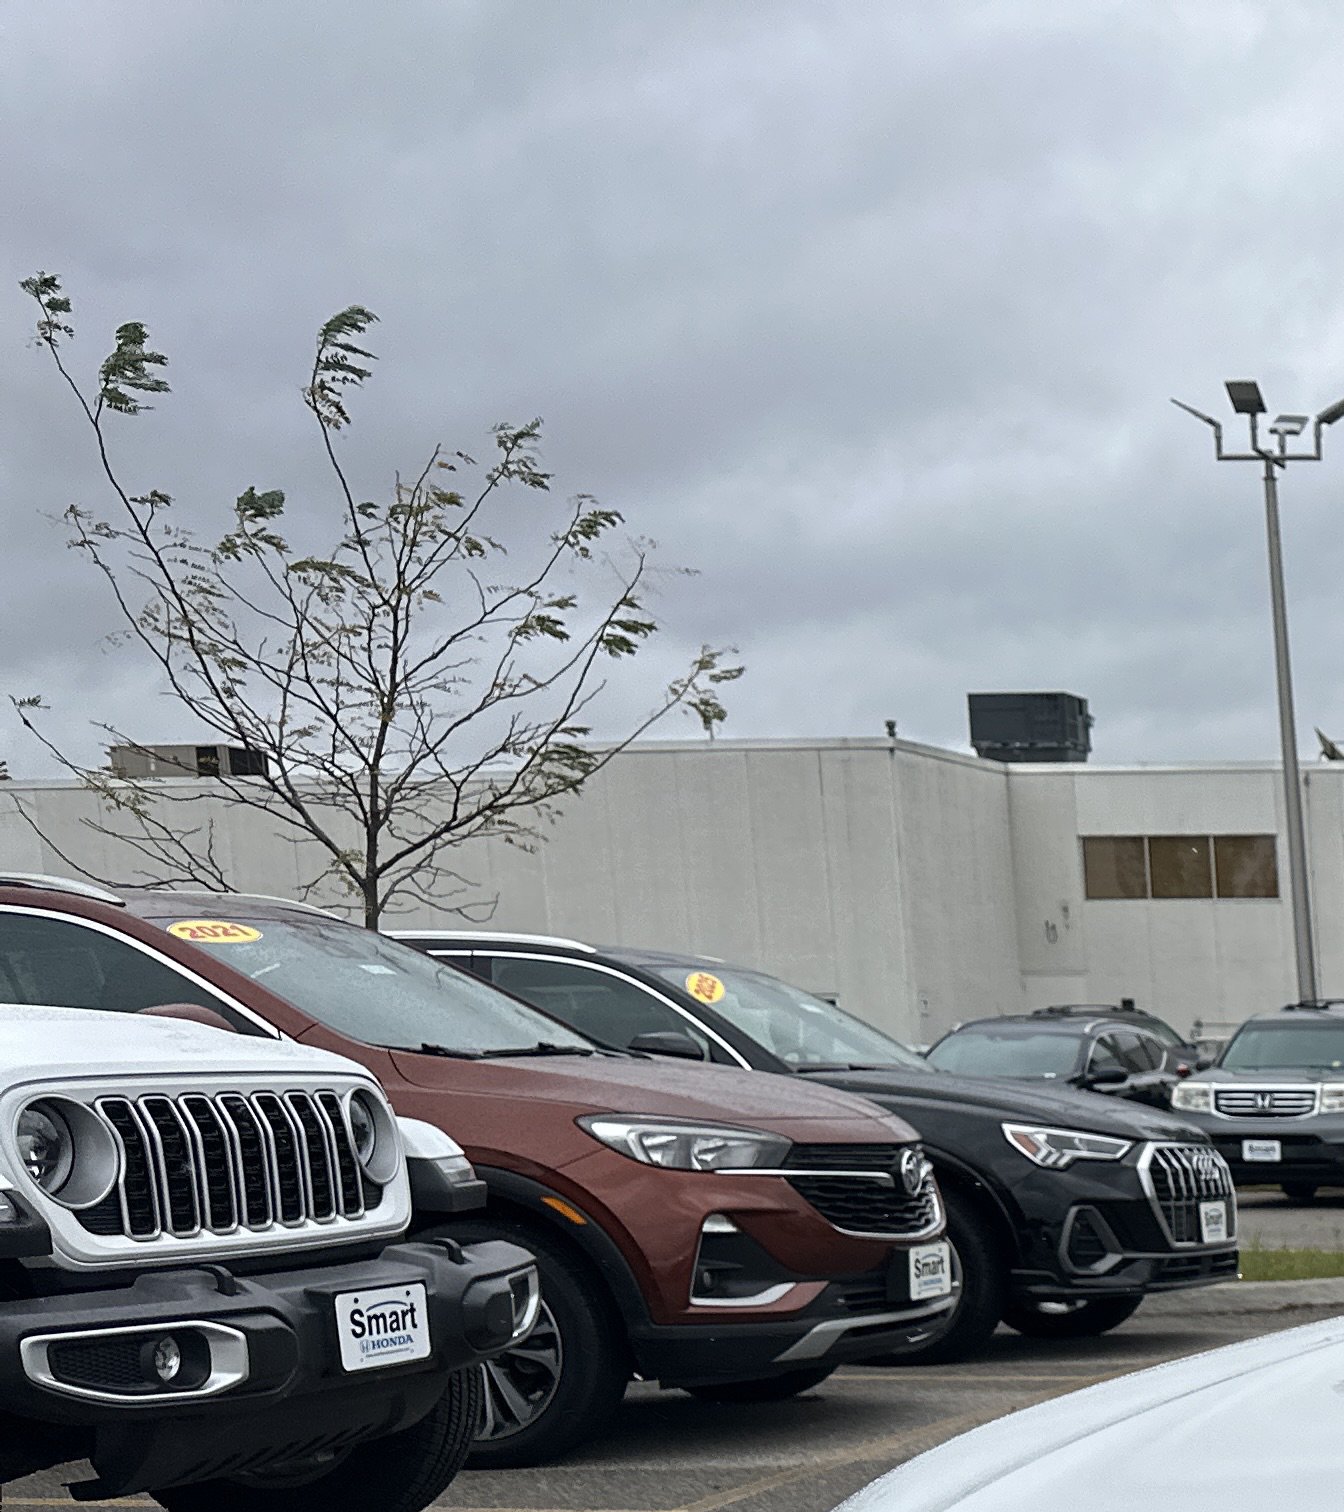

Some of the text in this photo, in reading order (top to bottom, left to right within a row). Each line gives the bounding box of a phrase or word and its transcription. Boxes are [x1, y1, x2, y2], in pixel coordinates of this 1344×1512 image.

[178, 924, 253, 939] 2021
[350, 1302, 418, 1339] Smart
[371, 1334, 414, 1350] HONDA
